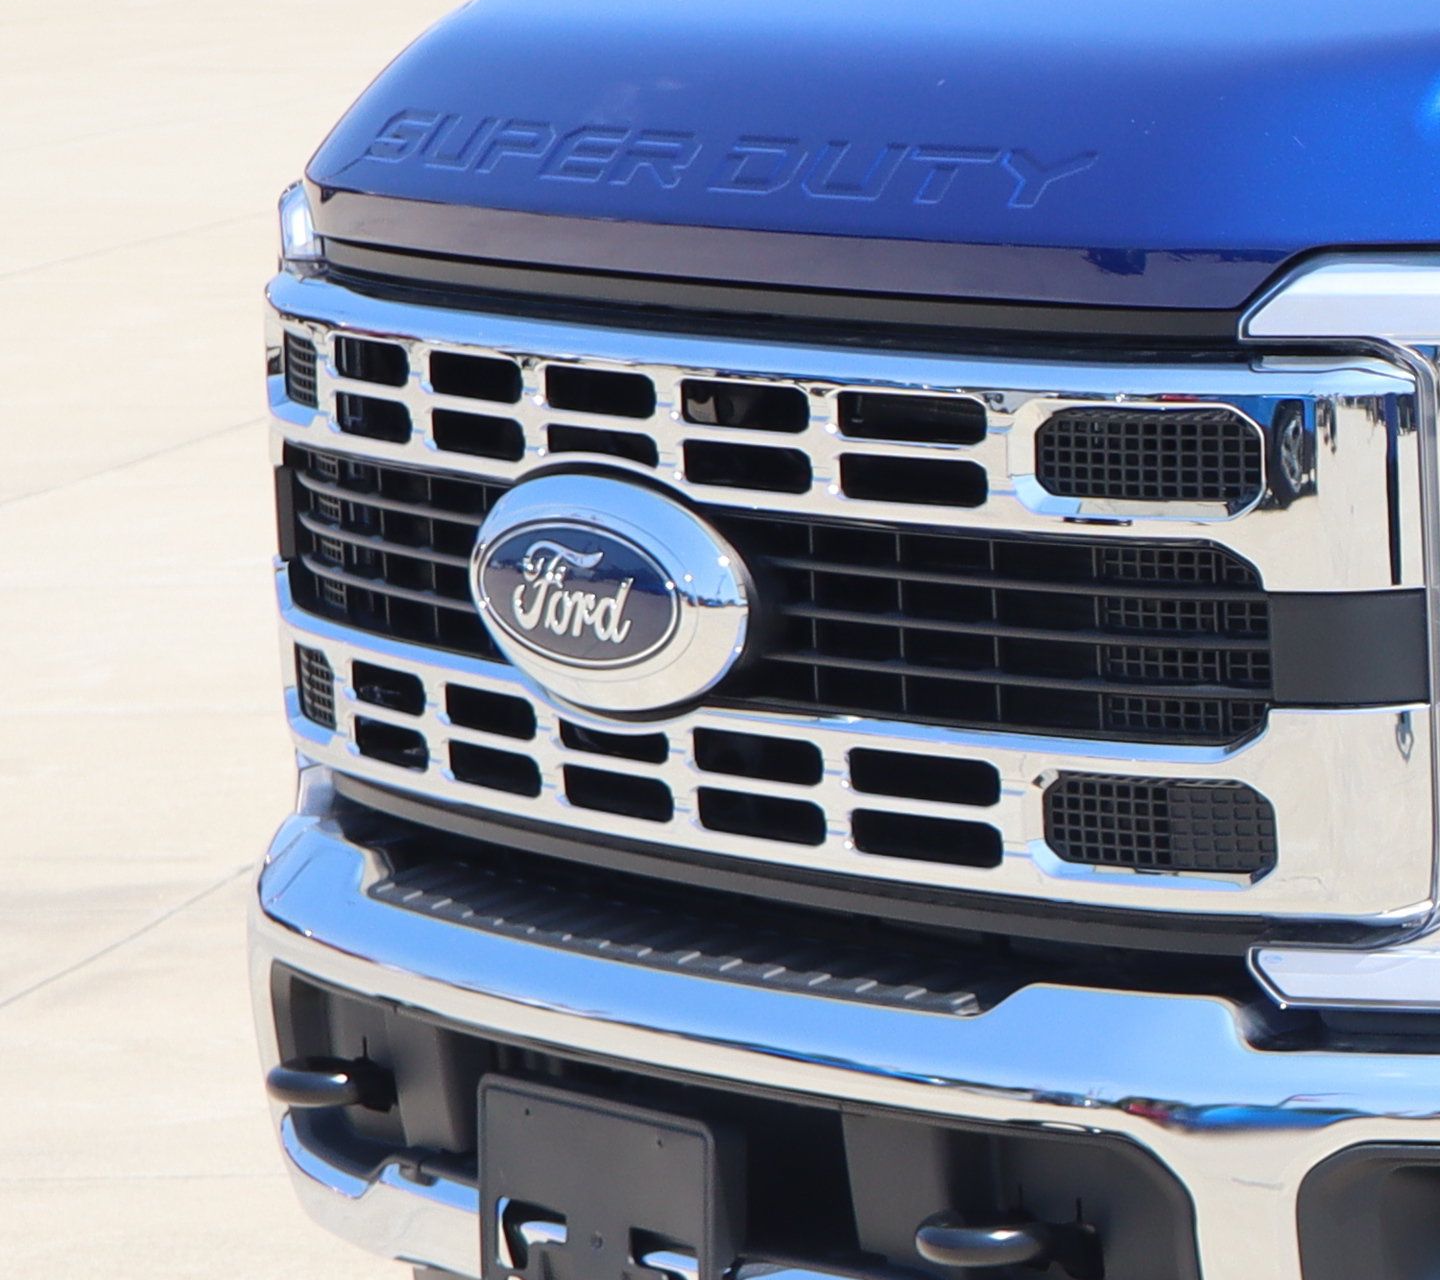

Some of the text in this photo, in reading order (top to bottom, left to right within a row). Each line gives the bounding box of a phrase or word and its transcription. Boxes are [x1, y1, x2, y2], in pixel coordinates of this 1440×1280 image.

[364, 108, 1099, 209] SUPER DUTY
[513, 540, 634, 643] Ford
